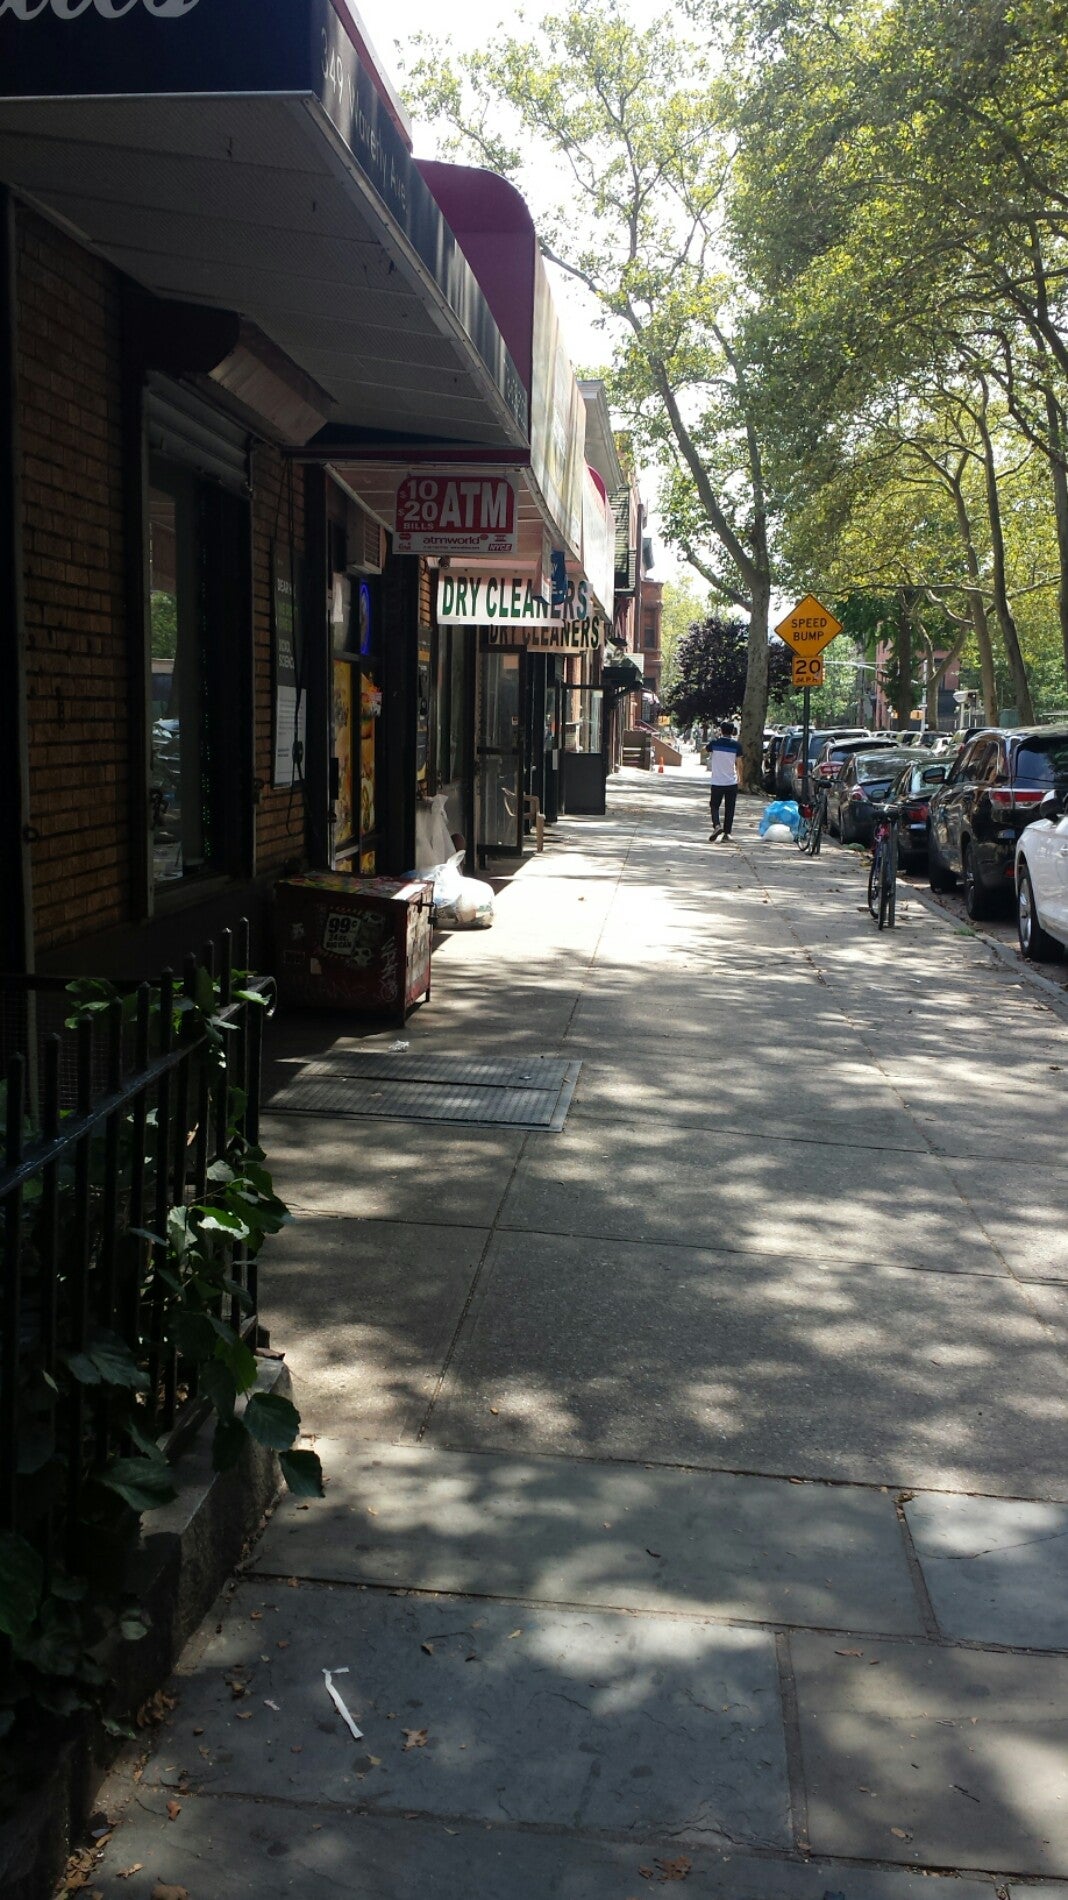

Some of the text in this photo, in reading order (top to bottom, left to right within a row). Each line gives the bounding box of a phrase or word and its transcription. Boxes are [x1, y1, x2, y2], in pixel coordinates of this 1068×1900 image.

[320, 26, 344, 105] 349
[400, 479, 439, 500] $10
[397, 500, 439, 522] $20
[439, 481, 508, 528] ATM
[403, 522, 436, 531] BILLS
[422, 535, 481, 545] atmworld
[441, 575, 483, 617] DRY
[488, 616, 600, 648] DRY CLEANERS
[791, 617, 827, 628] SPEED
[793, 631, 825, 641] BUMP
[795, 659, 821, 674] 20
